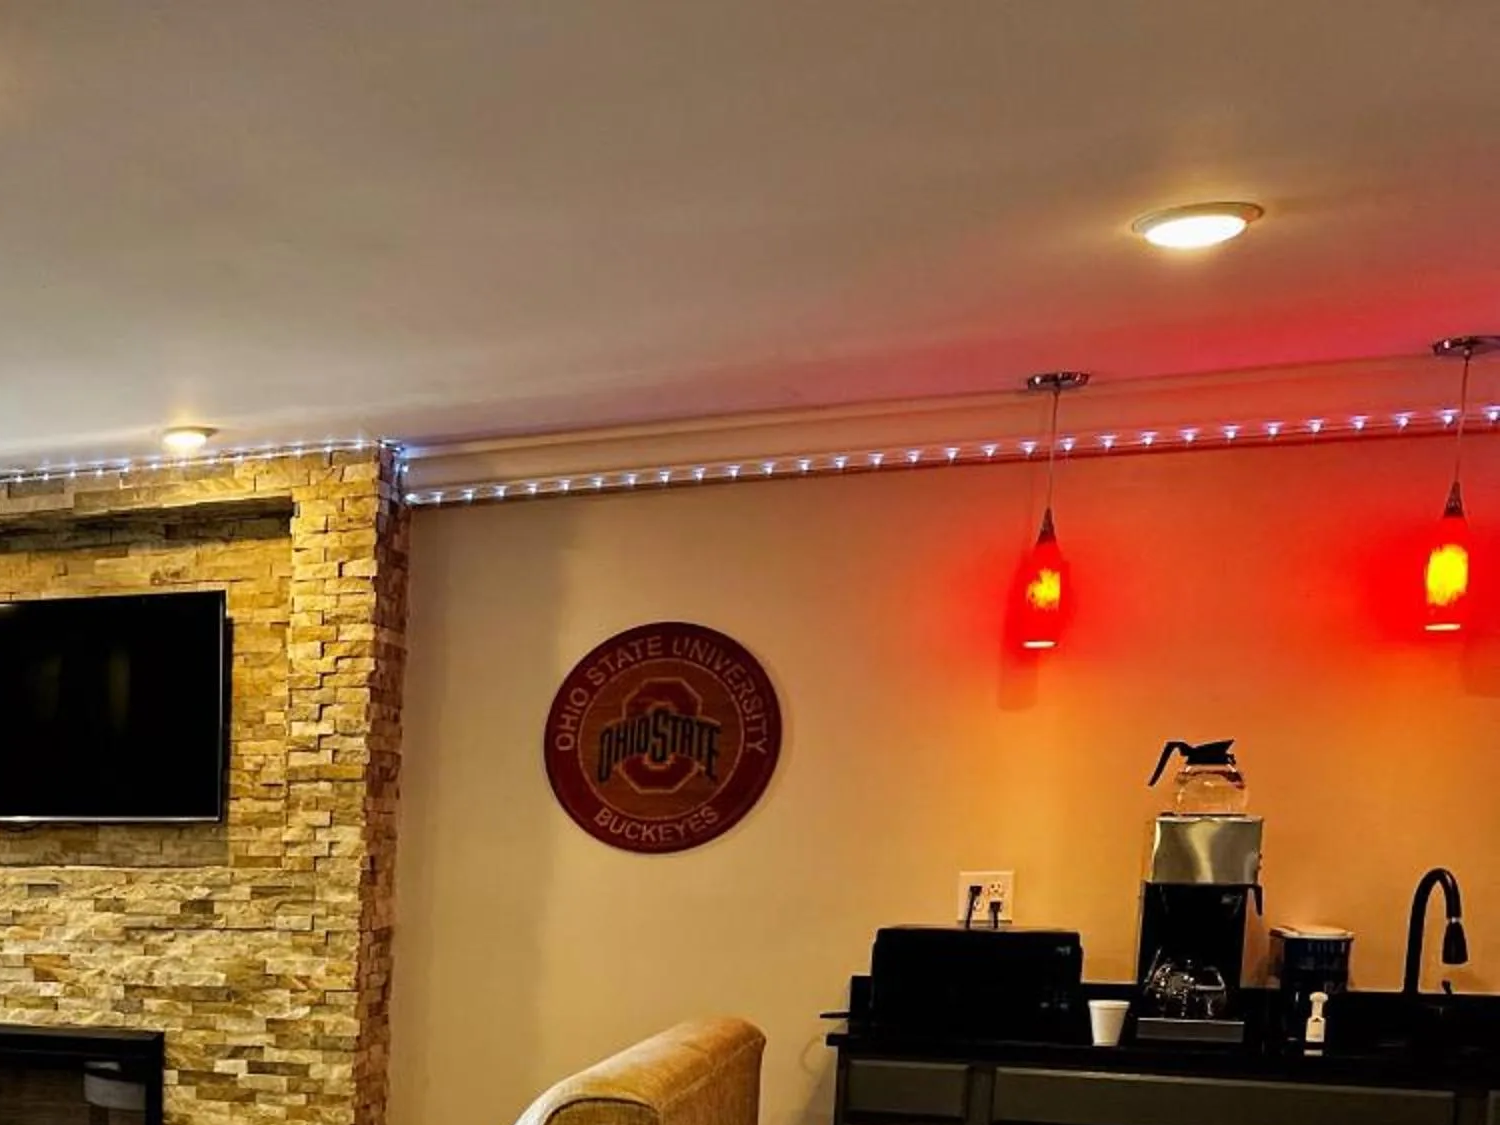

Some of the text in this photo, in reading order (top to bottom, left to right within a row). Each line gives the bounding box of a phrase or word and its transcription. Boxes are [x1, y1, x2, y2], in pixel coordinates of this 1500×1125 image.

[555, 635, 768, 755] OHIO STATE UNIVERSITY
[594, 806, 719, 842] BUCKEYES
